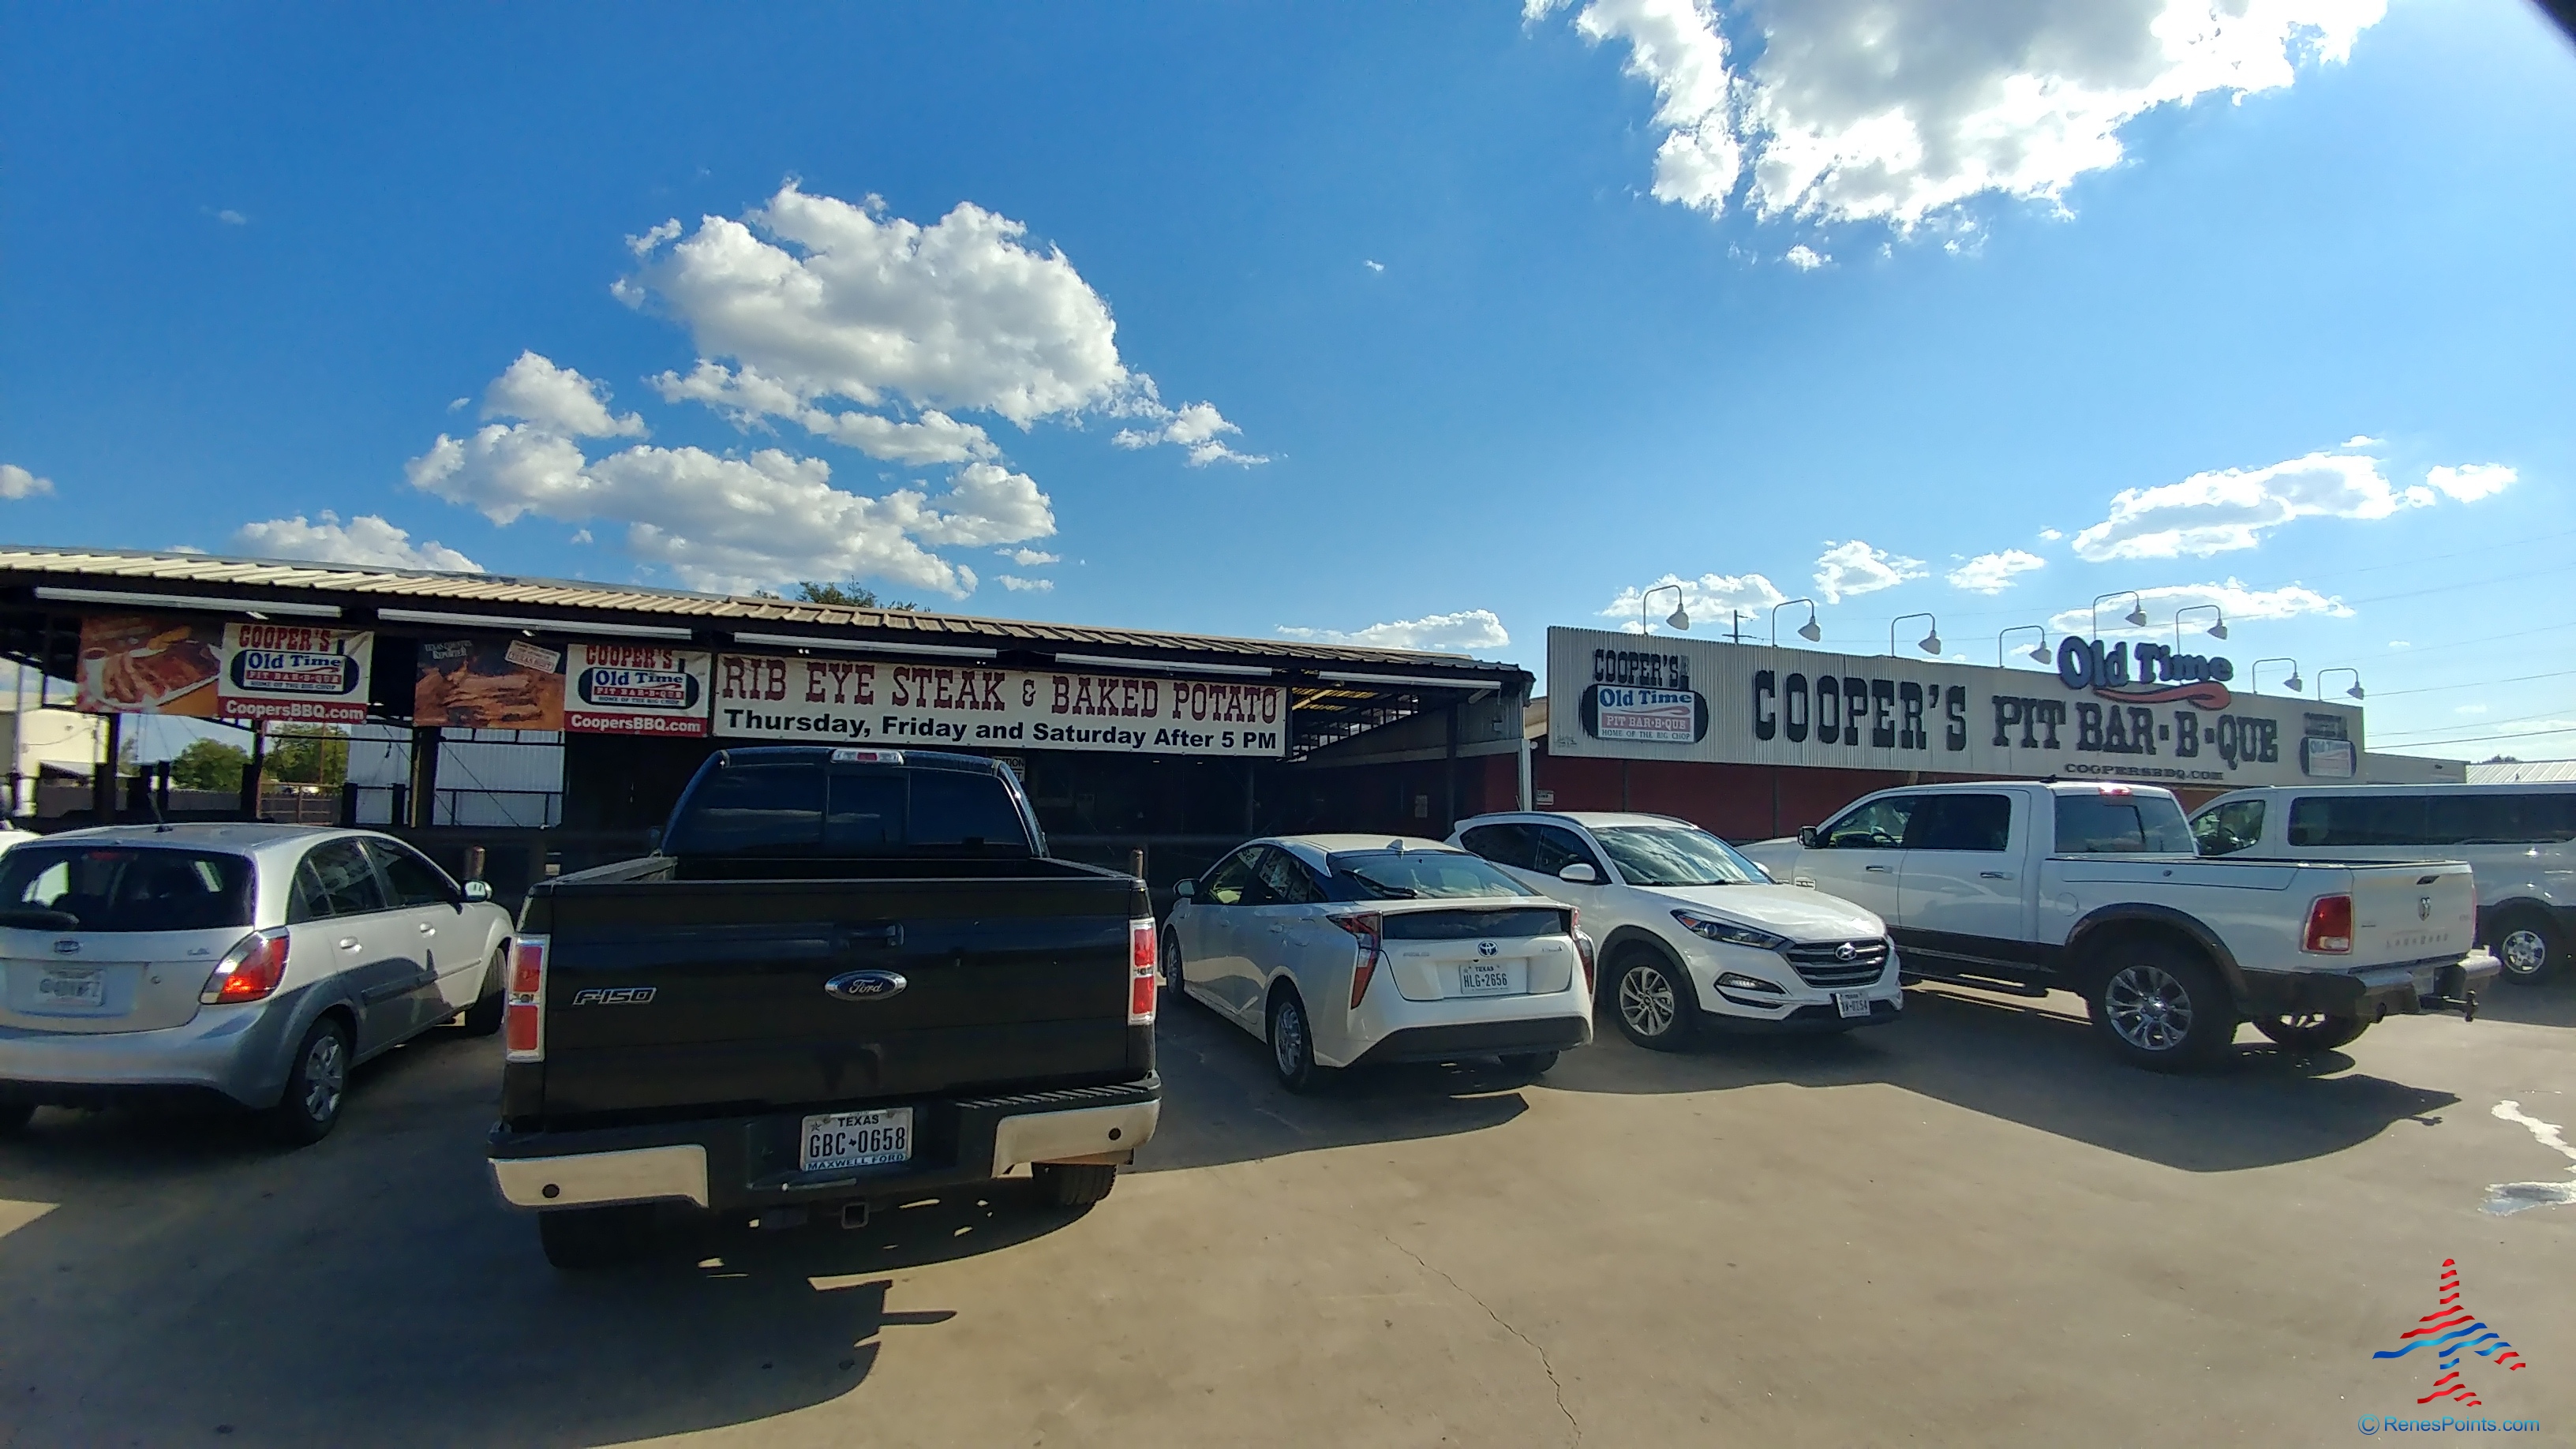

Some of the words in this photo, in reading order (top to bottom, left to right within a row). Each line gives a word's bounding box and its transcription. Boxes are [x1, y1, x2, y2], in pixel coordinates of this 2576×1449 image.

[239, 625, 331, 652] COOPER'S
[248, 652, 284, 669] Old
[290, 654, 341, 667] Time
[586, 645, 673, 669] COOPER'S
[2057, 635, 2130, 690] Old
[2134, 642, 2234, 684] Time
[249, 671, 270, 680] PIT
[1594, 648, 1679, 688] COOPER'S
[595, 670, 630, 686] Old
[635, 672, 683, 683] Time
[721, 657, 787, 702] RIB
[805, 661, 875, 706] EYE
[892, 667, 1005, 711] STEAK
[1022, 680, 1036, 707] &
[1051, 675, 1159, 719] BAKED
[1172, 681, 1277, 724] POTATO
[1599, 688, 1634, 707] Old
[1638, 690, 1692, 705] Time
[226, 699, 365, 721] CoopersBBQ.com
[1754, 670, 1967, 751] COOPER'S
[571, 714, 701, 732] CoopersBBQ.com
[724, 709, 871, 738] Thursday,
[882, 716, 968, 742] Friday
[975, 722, 1024, 740] and
[1032, 723, 1147, 749] Saturday
[1153, 728, 1215, 748] After
[1222, 732, 1234, 748] 5
[1243, 731, 1277, 750] PM
[1606, 716, 1626, 726] PIT
[1992, 695, 2066, 749] PIT
[572, 987, 657, 1005] F-150
[848, 979, 883, 995] Ford
[837, 1114, 879, 1128] TEXAS
[807, 1156, 868, 1170] MAXWELL
[872, 1153, 904, 1163] FORD
